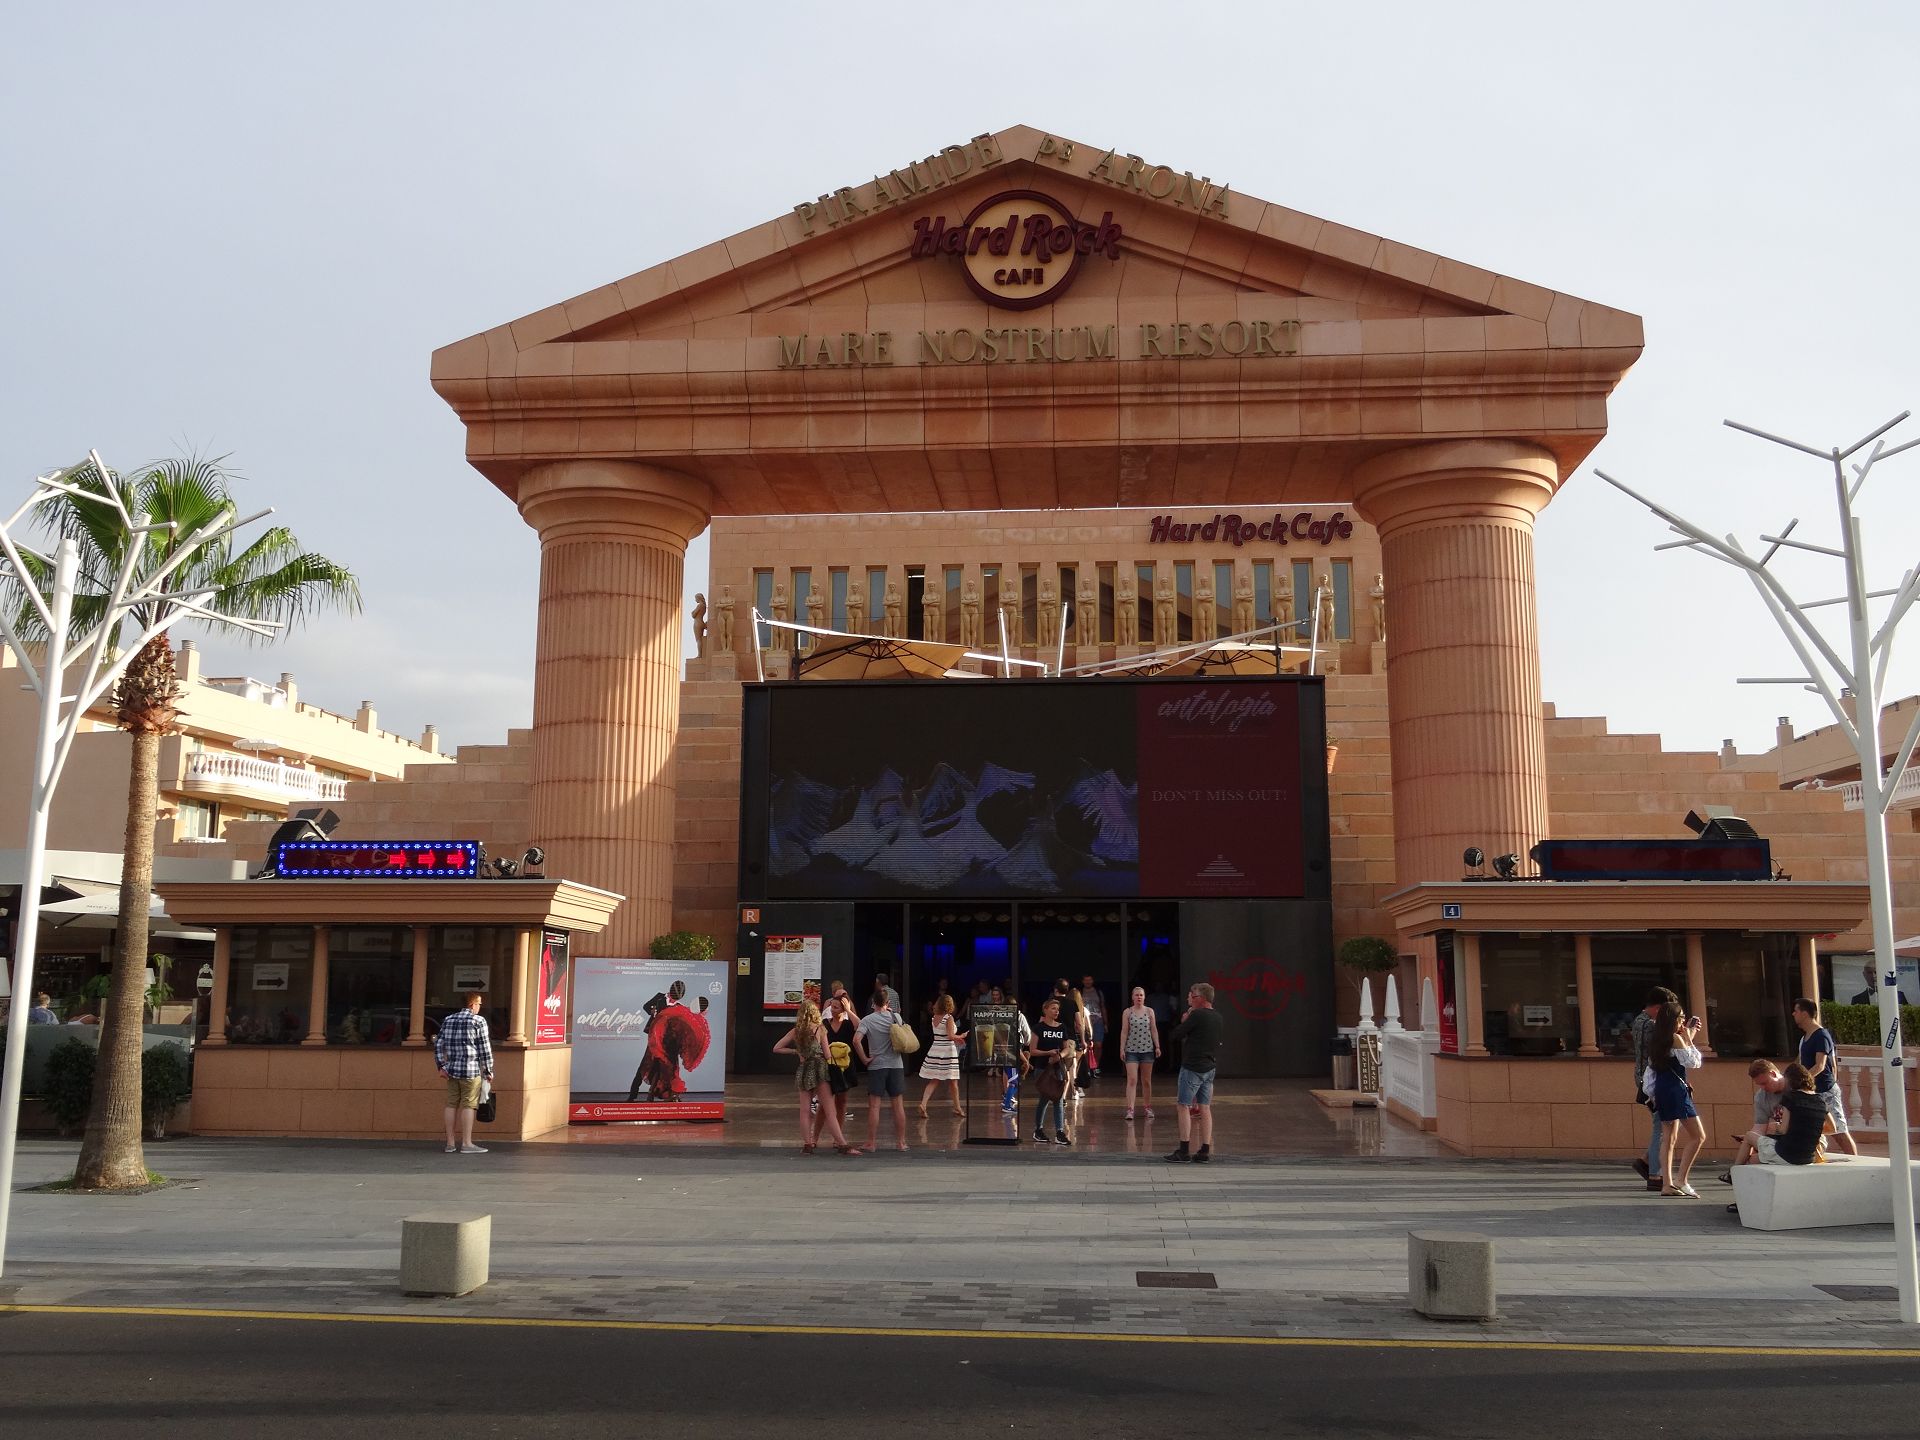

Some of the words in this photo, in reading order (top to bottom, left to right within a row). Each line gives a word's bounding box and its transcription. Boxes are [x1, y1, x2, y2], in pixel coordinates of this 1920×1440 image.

[794, 132, 1003, 237] PIRAMIDE
[1038, 133, 1076, 163] DE
[1088, 147, 1232, 220] ARONA
[910, 214, 1018, 258] Hard
[1020, 211, 1123, 264] Rock
[993, 268, 1044, 286] CAFE
[778, 331, 894, 369] MARE
[917, 323, 1116, 365] NOSTRUM
[1140, 319, 1301, 360] RESORT
[1150, 514, 1222, 543] Hard
[1222, 513, 1289, 547] Rock
[1290, 512, 1354, 546] Cafe
[1152, 789, 1201, 802] DON'T
[1207, 789, 1243, 802] MISS
[1248, 789, 1287, 802] OUT!
[746, 910, 756, 922] R
[1449, 906, 1455, 916] 4
[1361, 1051, 1369, 1091] ENTRADA
